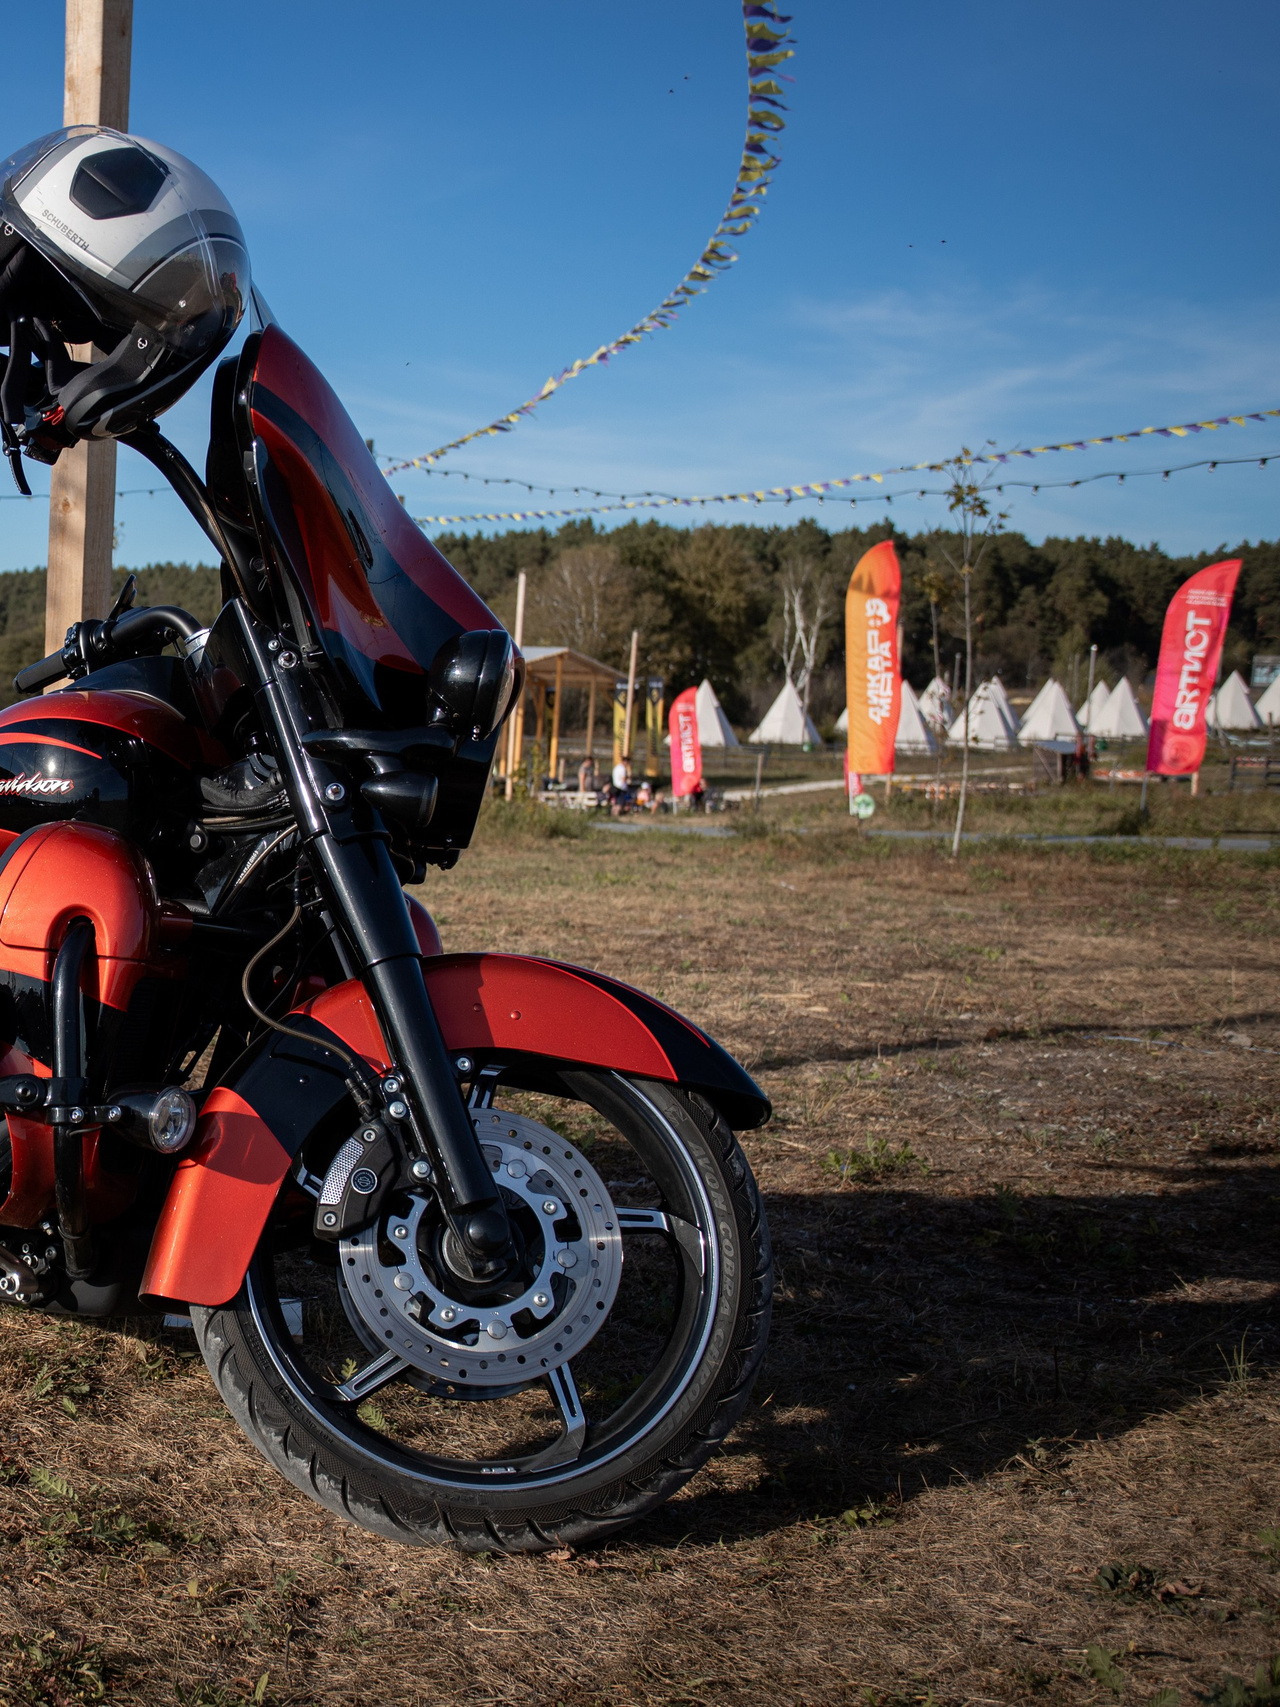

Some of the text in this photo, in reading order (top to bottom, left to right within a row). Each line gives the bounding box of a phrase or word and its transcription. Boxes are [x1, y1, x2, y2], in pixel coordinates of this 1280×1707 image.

[41, 208, 90, 251] SCHUBERTH
[660, 1140, 735, 1440] AVON COBRA CHROME
